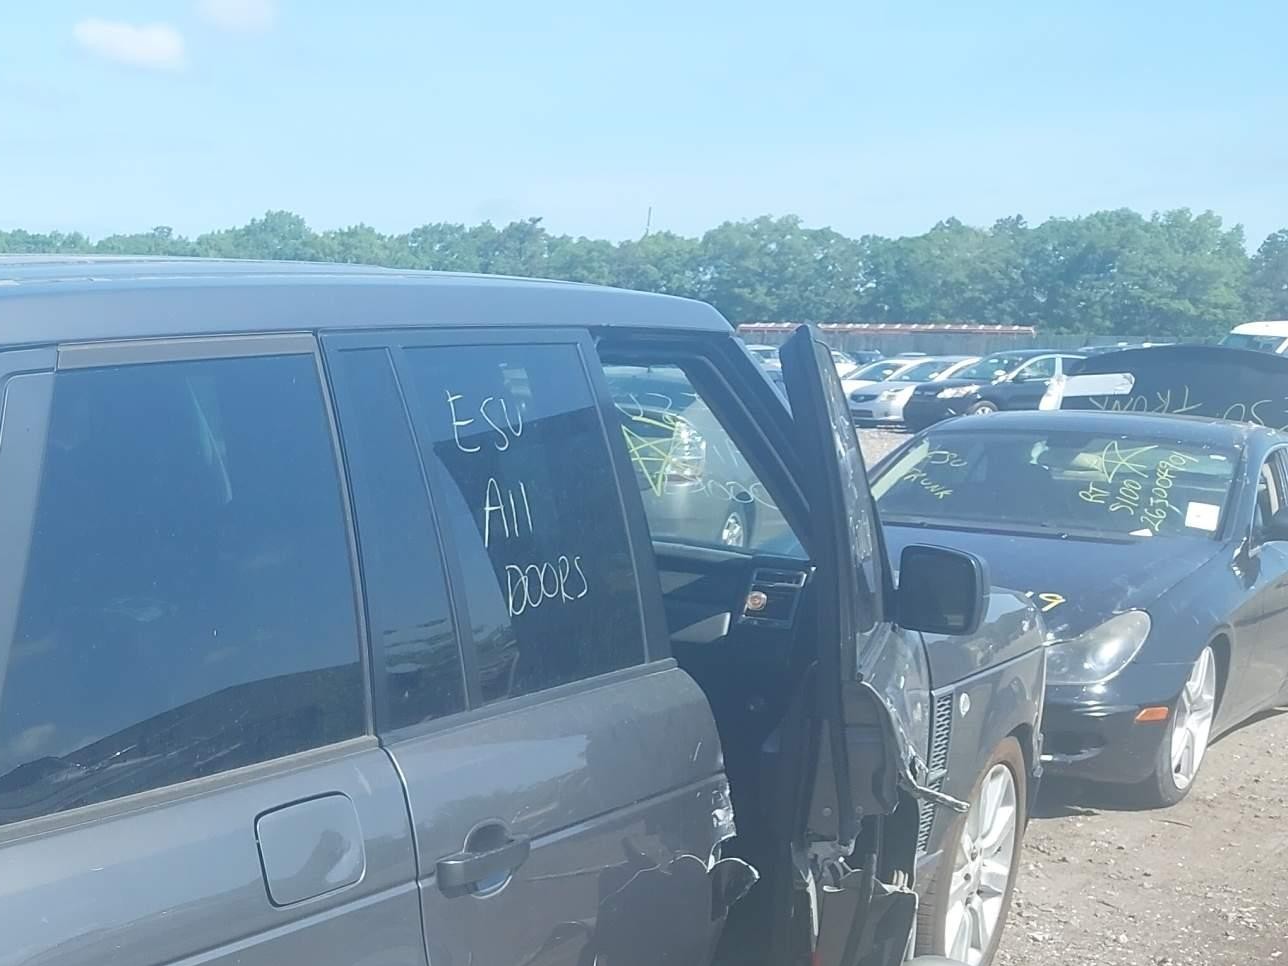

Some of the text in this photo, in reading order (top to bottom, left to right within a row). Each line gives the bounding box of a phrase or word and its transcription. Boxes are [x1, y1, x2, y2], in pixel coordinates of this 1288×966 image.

[445, 390, 523, 453] ESU
[1078, 481, 1111, 503] RT
[505, 555, 587, 617] DOORS
